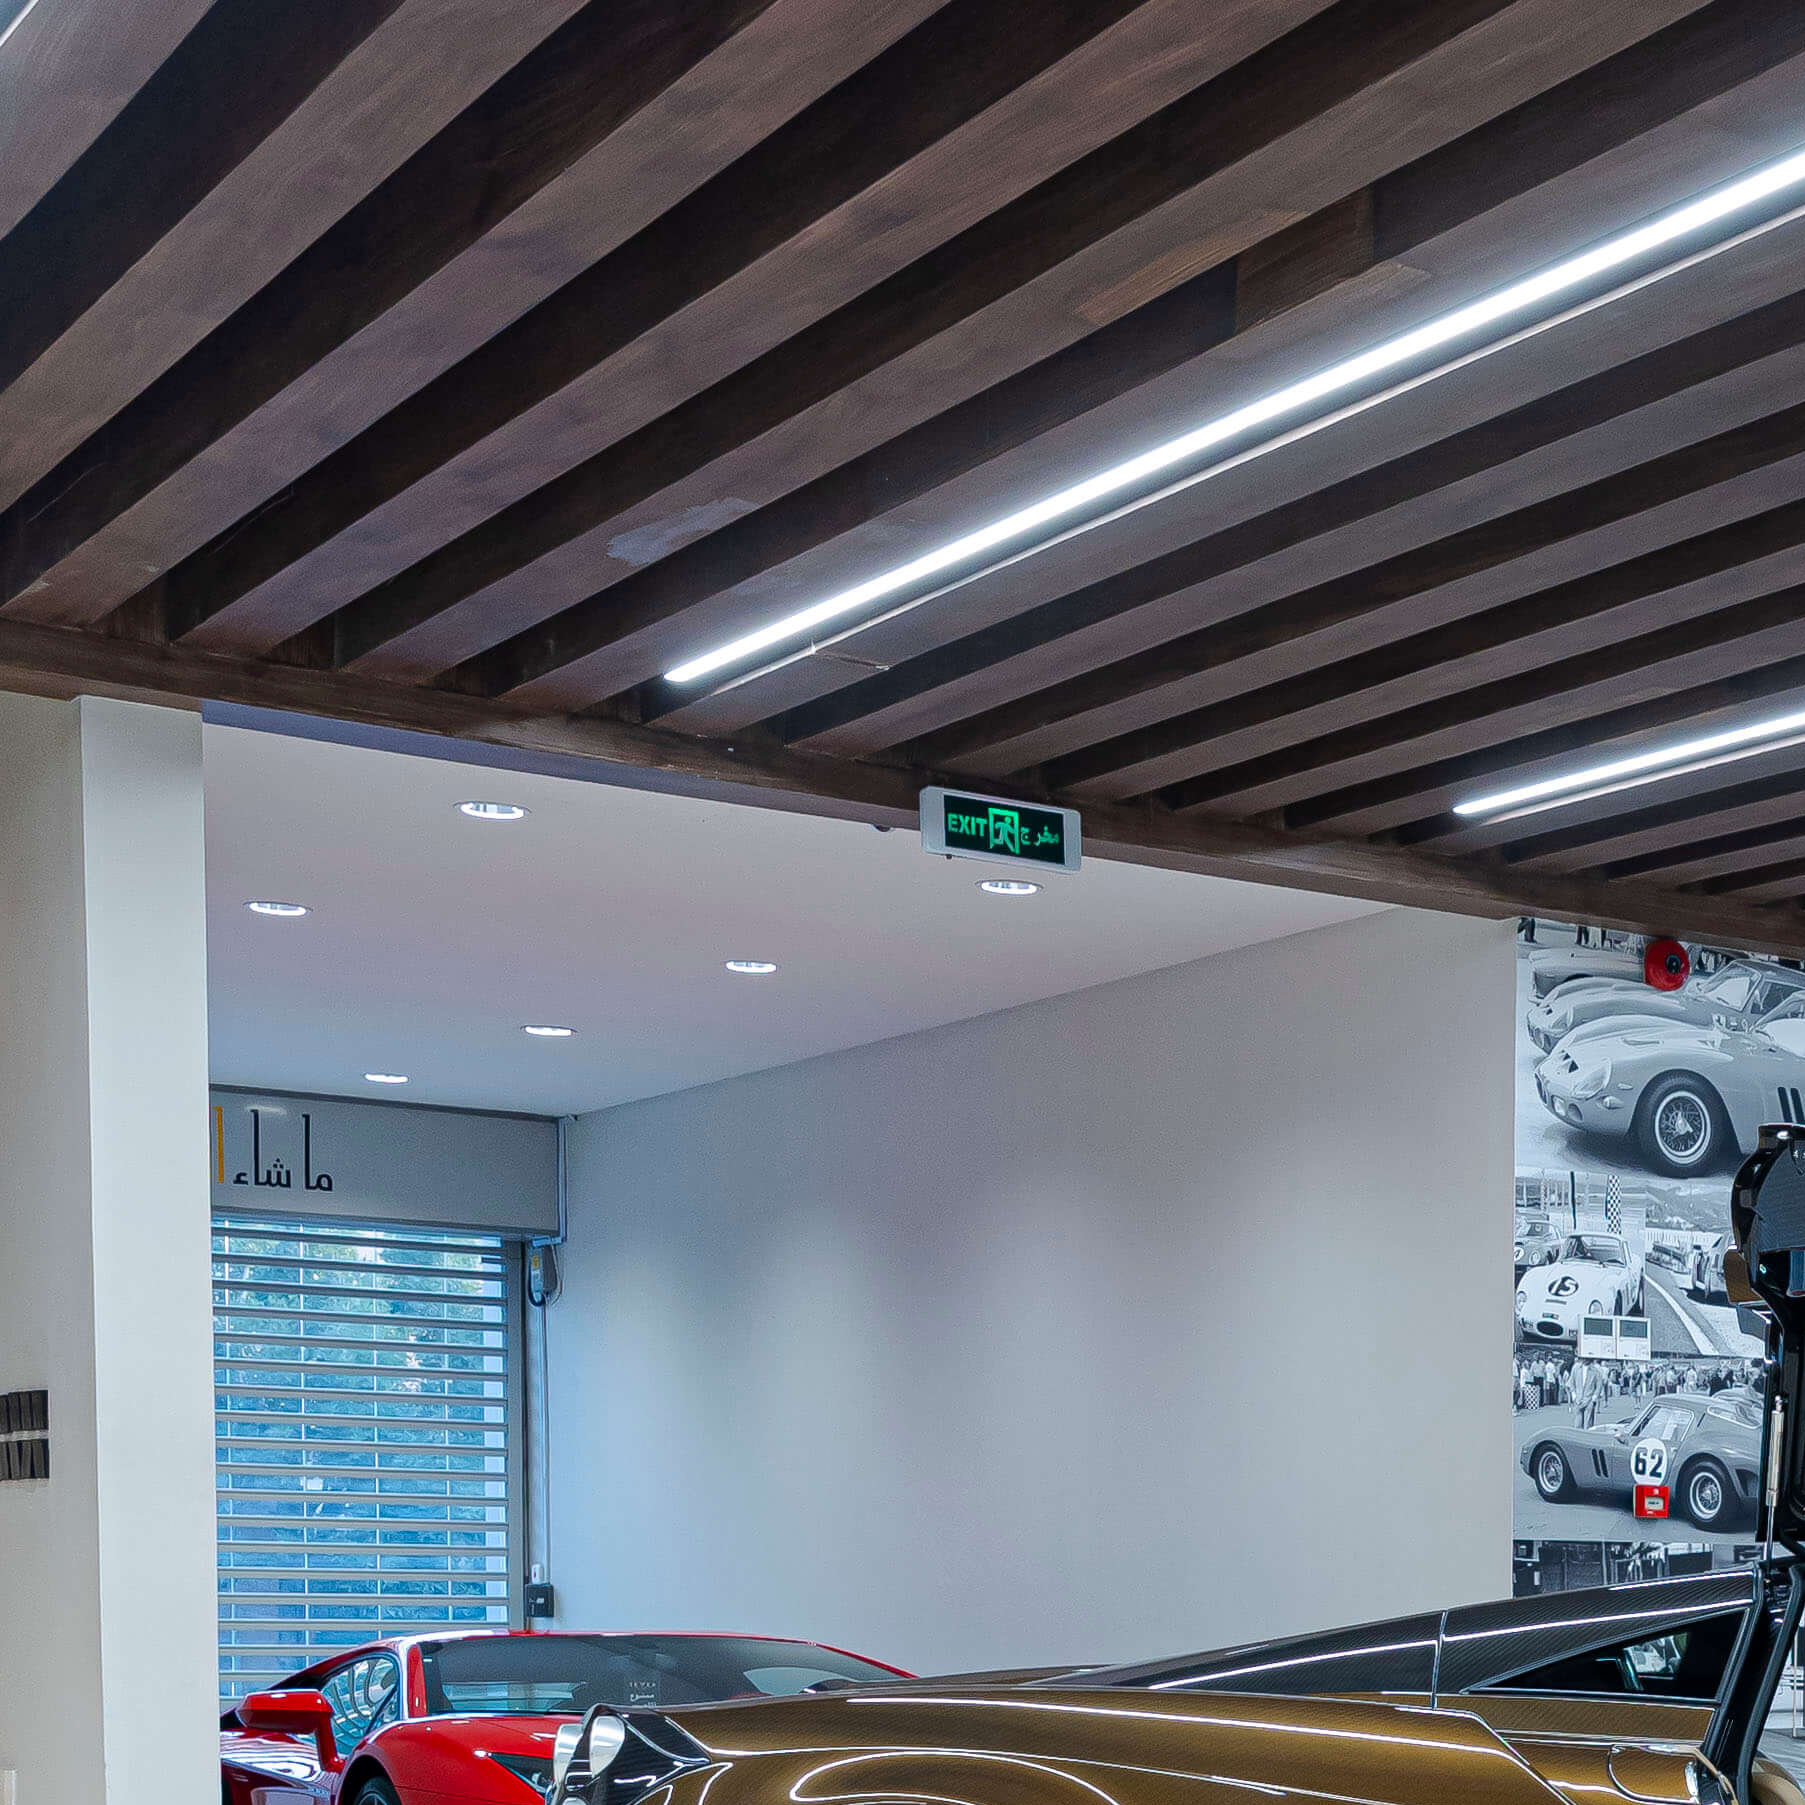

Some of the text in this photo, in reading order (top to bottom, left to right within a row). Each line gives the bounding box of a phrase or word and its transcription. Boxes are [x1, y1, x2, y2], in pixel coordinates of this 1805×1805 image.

[948, 812, 988, 837] EXIT
[1020, 825, 1060, 847] مخرج
[232, 1108, 291, 1189] شاء
[302, 1113, 333, 1192] ما
[1634, 1446, 1665, 1478] 62
